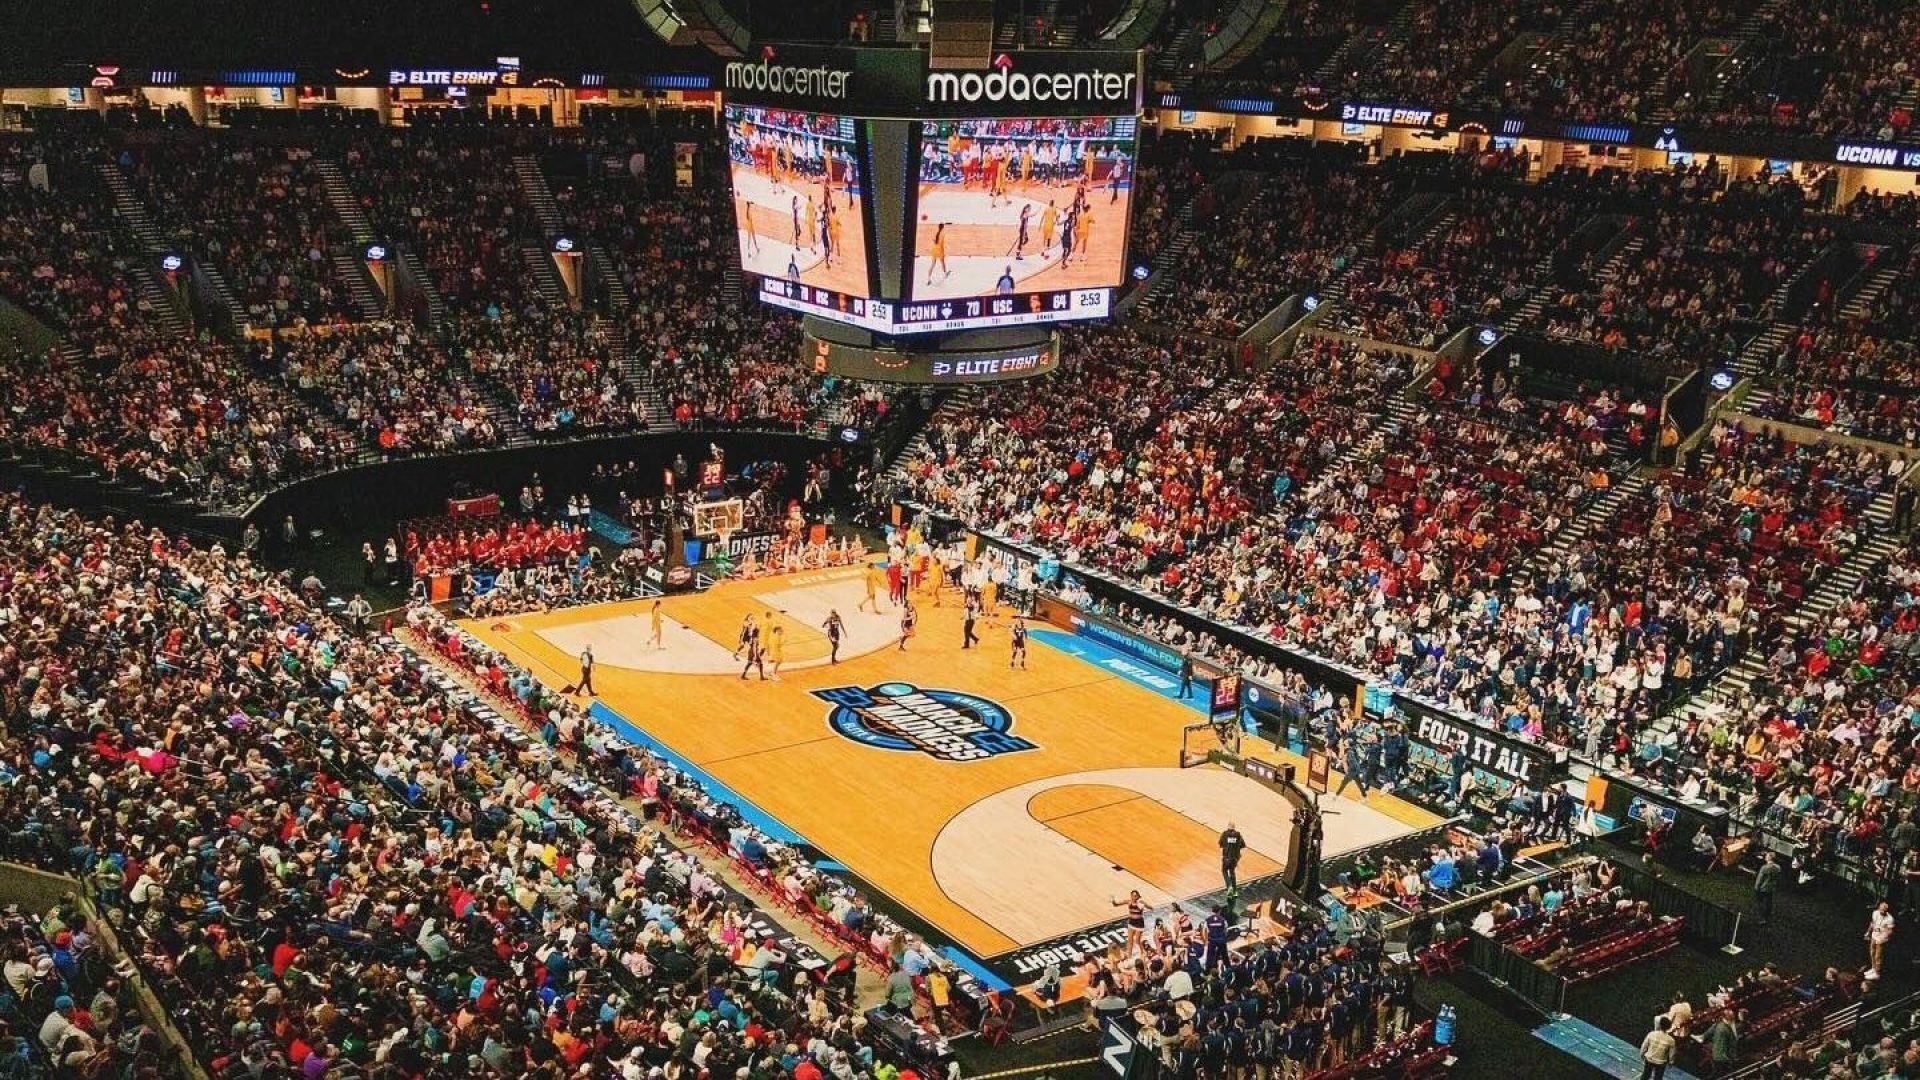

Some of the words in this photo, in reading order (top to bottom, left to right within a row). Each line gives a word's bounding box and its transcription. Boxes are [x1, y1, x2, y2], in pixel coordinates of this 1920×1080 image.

[409, 71, 452, 84] ELITE
[452, 71, 498, 84] EIGHT
[1357, 106, 1393, 122] ELITE
[1392, 108, 1432, 126] EIGHT
[1836, 144, 1898, 165] UCONN
[902, 304, 938, 321] UCONN
[966, 300, 981, 317] 70
[992, 299, 1013, 314] USC
[1080, 292, 1101, 306] 2:53
[955, 359, 999, 376] ELITE
[1000, 355, 1040, 372] EIGHT
[890, 692, 990, 735] MARCH
[864, 703, 994, 762] MADNESS
[1471, 735, 1497, 765] IT
[1495, 747, 1532, 781] ALL
[1014, 943, 1078, 974] EIGHT
